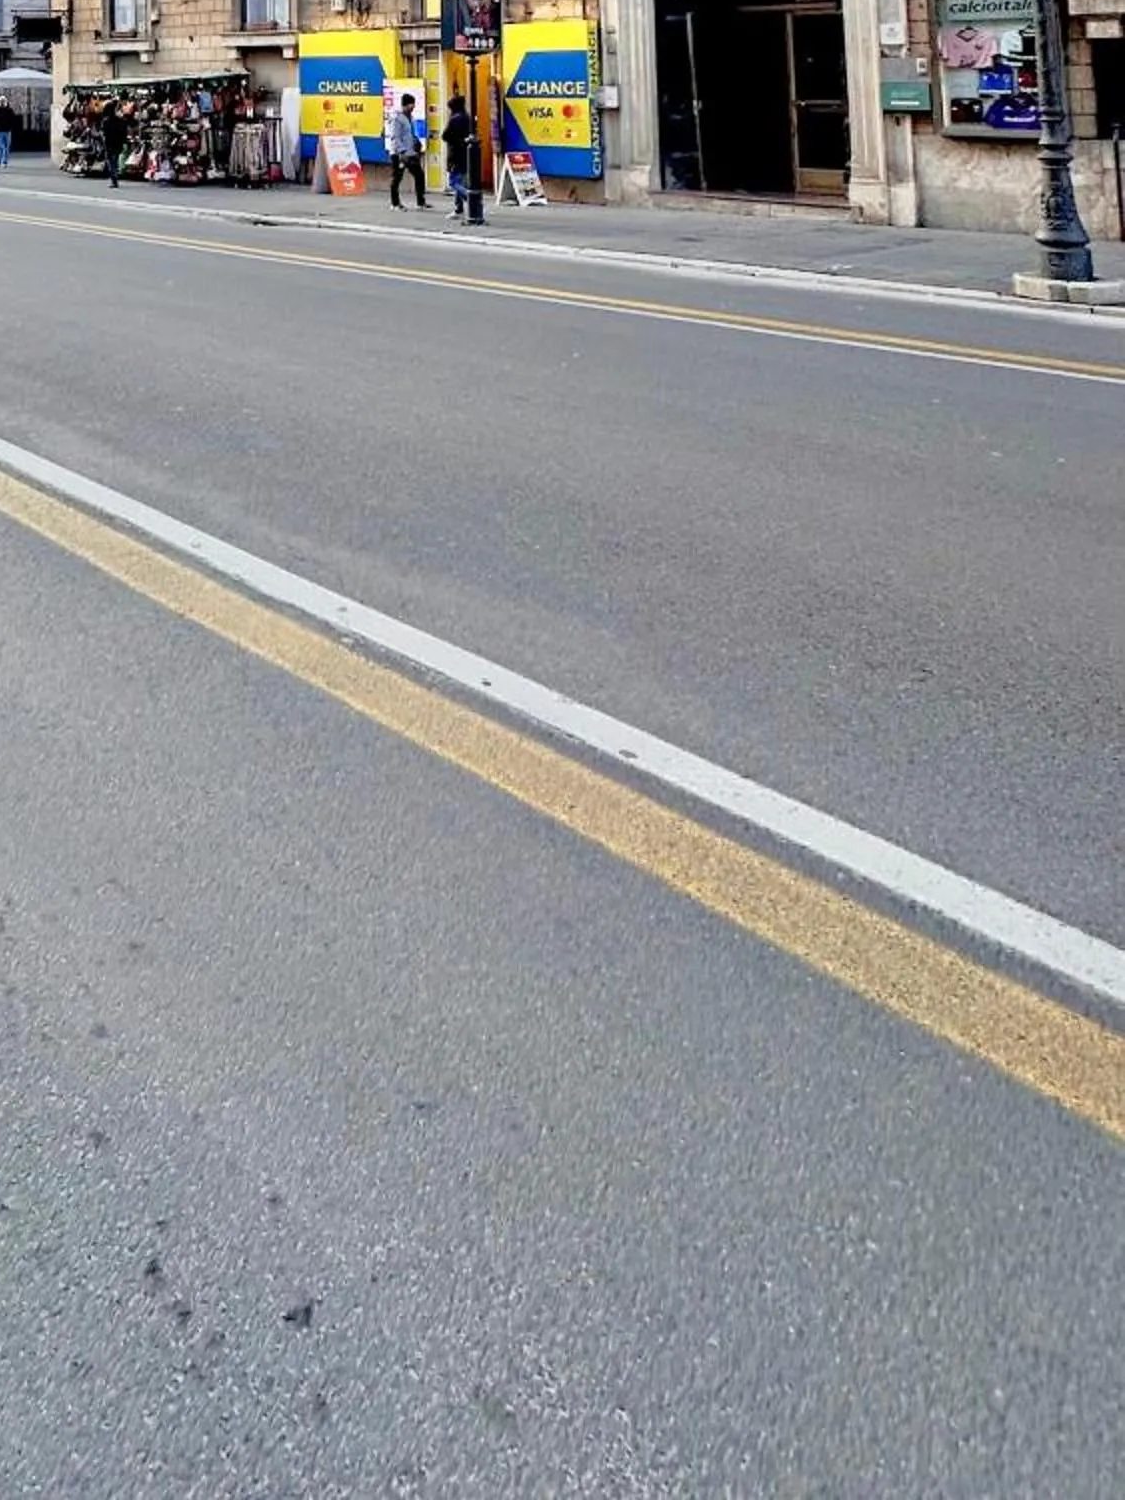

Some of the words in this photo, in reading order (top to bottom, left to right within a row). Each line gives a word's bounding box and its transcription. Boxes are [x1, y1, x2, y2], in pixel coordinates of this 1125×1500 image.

[318, 80, 368, 93] CHANGE
[515, 80, 586, 96] CHANGE
[345, 102, 364, 113] VISA
[527, 106, 554, 120] VISA
